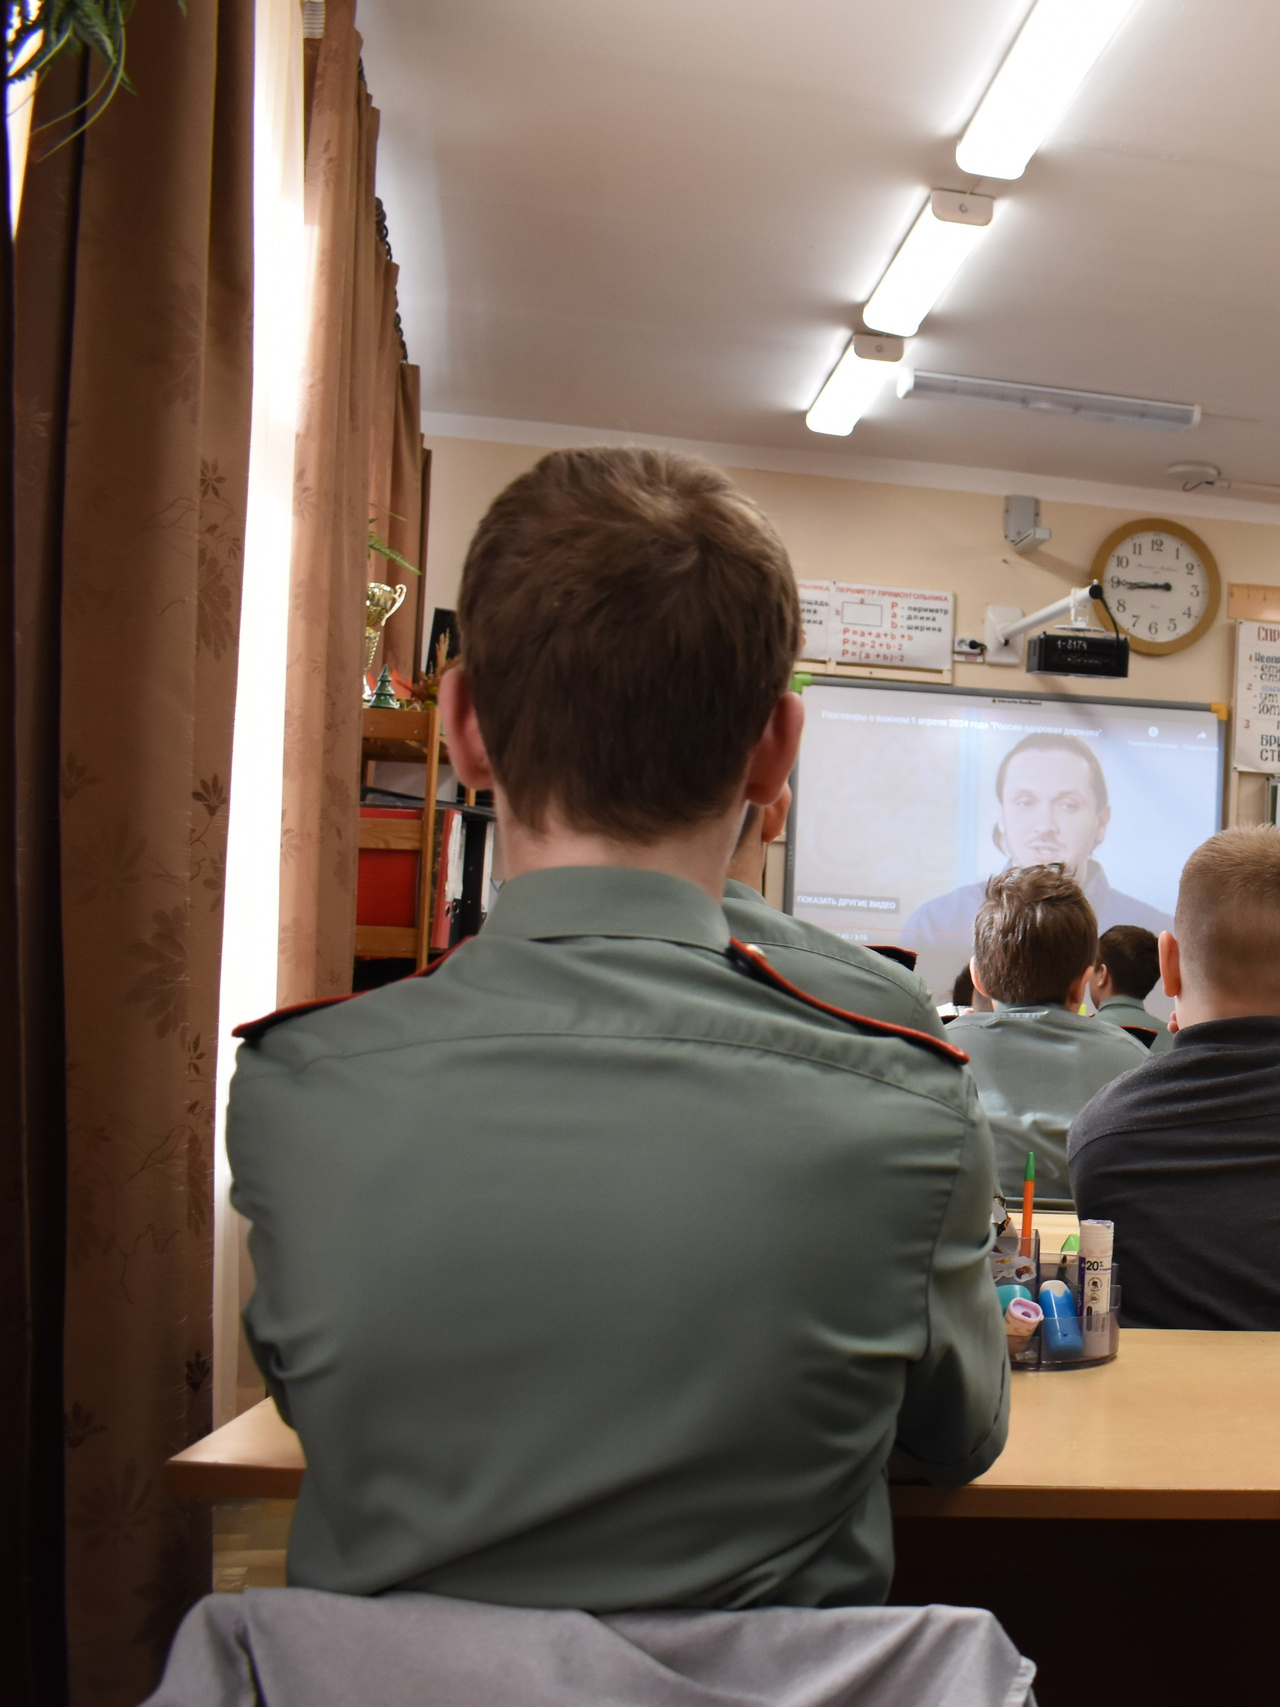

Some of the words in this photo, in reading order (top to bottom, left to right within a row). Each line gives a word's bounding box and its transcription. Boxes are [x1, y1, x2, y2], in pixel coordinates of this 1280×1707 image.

[1133, 543, 1142, 555] 11
[1151, 539, 1163, 552] 12
[1175, 547, 1179, 559] 1
[1116, 555, 1129, 568] 10
[1186, 562, 1195, 575] 2
[1110, 575, 1121, 588] 9
[835, 586, 876, 596] ПЕРИМЕТР
[878, 590, 949, 602] ПРЯМОУГОЛЬНИКА
[1190, 584, 1200, 597] 3
[800, 599, 829, 607] ощадь
[1116, 599, 1126, 612] 8
[907, 605, 949, 615] периметр
[1182, 606, 1192, 618] 4
[906, 614, 937, 622] длина
[1131, 614, 1140, 627] 7
[906, 624, 942, 633] ширина
[1148, 622, 1158, 635] 6
[1167, 618, 1177, 632] 5
[822, 710, 867, 722] Разговоры
[876, 715, 910, 724] важном
[918, 718, 947, 728] апреля
[949, 718, 968, 729] 2024
[970, 720, 989, 731] года
[797, 895, 837, 906] ПОКАЗАТЬ
[838, 898, 868, 908] ДРУГИЕ
[869, 900, 896, 910] ВИДЕО
[1086, 1260, 1099, 1271] 20
